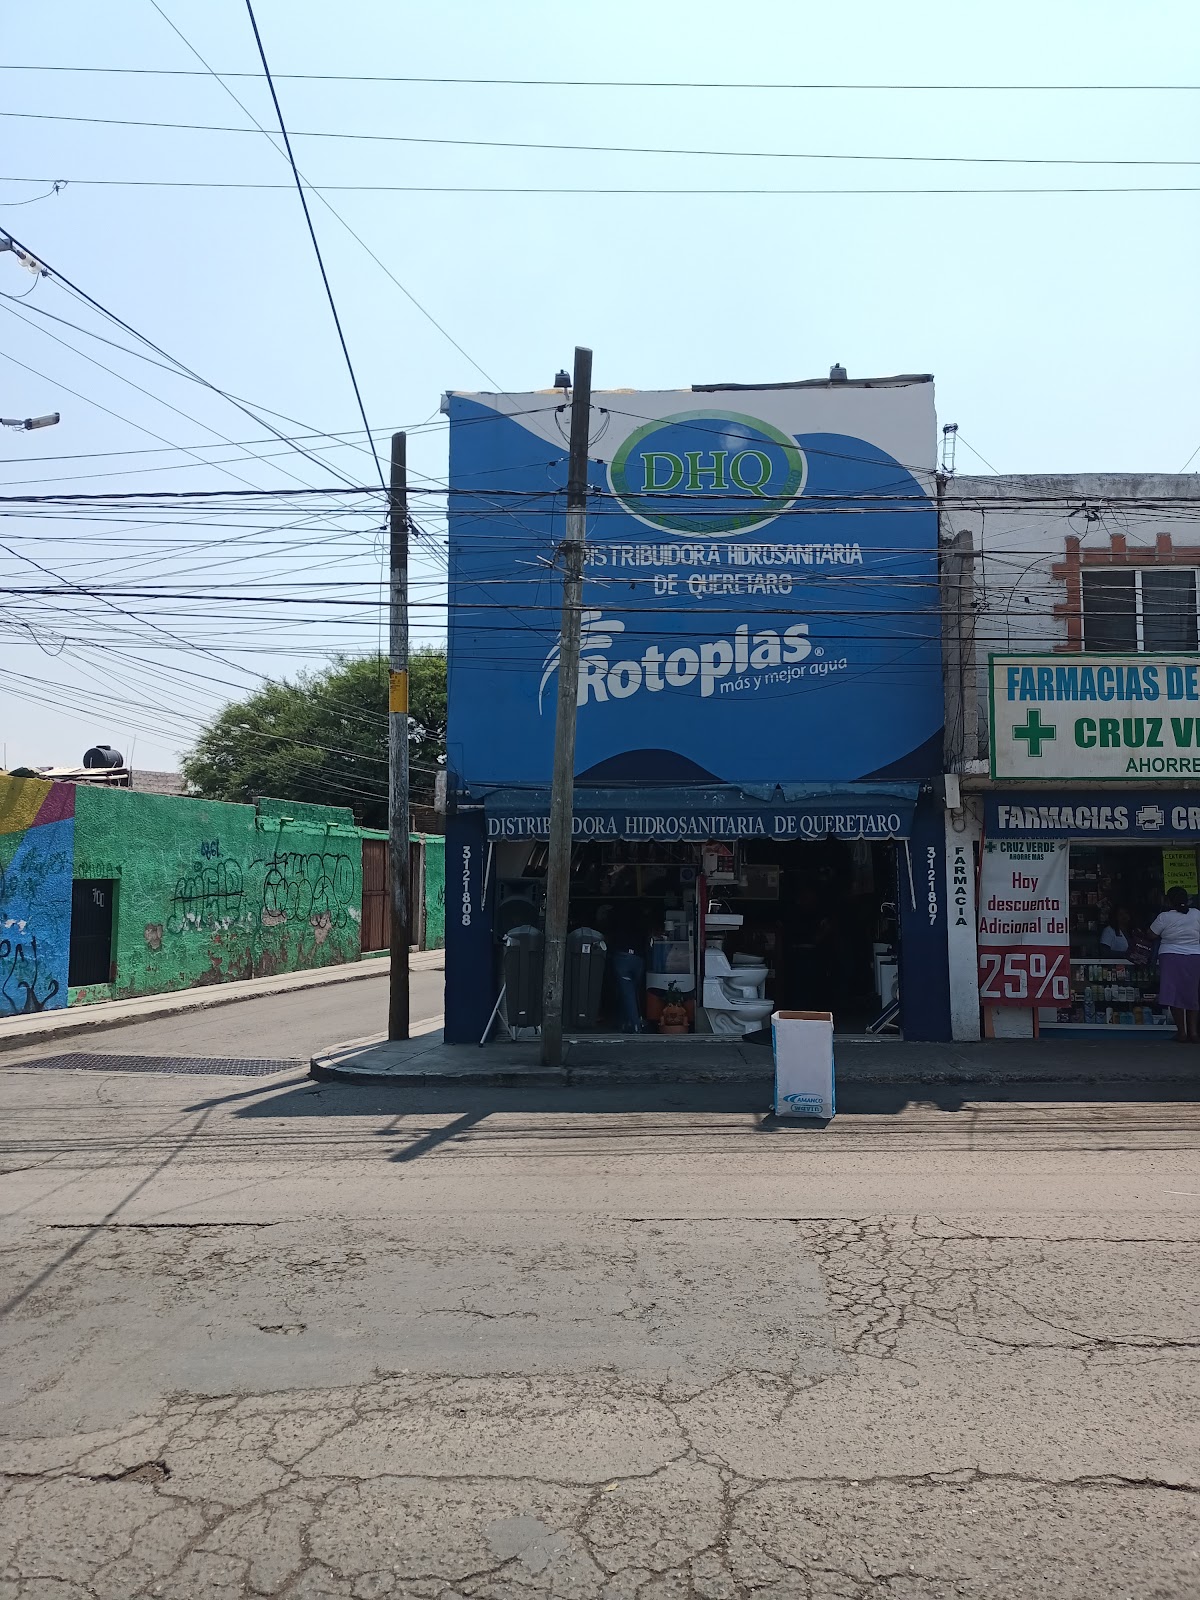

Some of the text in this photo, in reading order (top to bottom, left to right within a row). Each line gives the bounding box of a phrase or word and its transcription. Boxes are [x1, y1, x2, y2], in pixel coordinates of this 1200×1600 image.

[640, 450, 772, 501] DHQ
[727, 543, 863, 566] HIDROSANITARIA
[654, 574, 793, 599] DE QUERETARO
[577, 623, 812, 706] Rotoplas
[720, 657, 848, 694] más y mejor agua
[1007, 665, 1199, 701] FARMACIAS DE
[1074, 717, 1164, 748] CRUZ
[1125, 757, 1200, 773] AHORRE
[488, 814, 901, 838] DISTRIBDORA HIDROSANITARIA DE QUERETARO
[997, 805, 1129, 830] FARMACIAS
[1000, 842, 1055, 853] CRUZ VERDE
[461, 845, 472, 926] 3121808
[926, 846, 938, 926] 3121807
[953, 847, 968, 926] FARMACIA
[1012, 871, 1039, 892] Hoy
[987, 894, 1060, 911] descuento
[979, 916, 1068, 934] Adicional del
[979, 953, 1070, 1000] 25%
